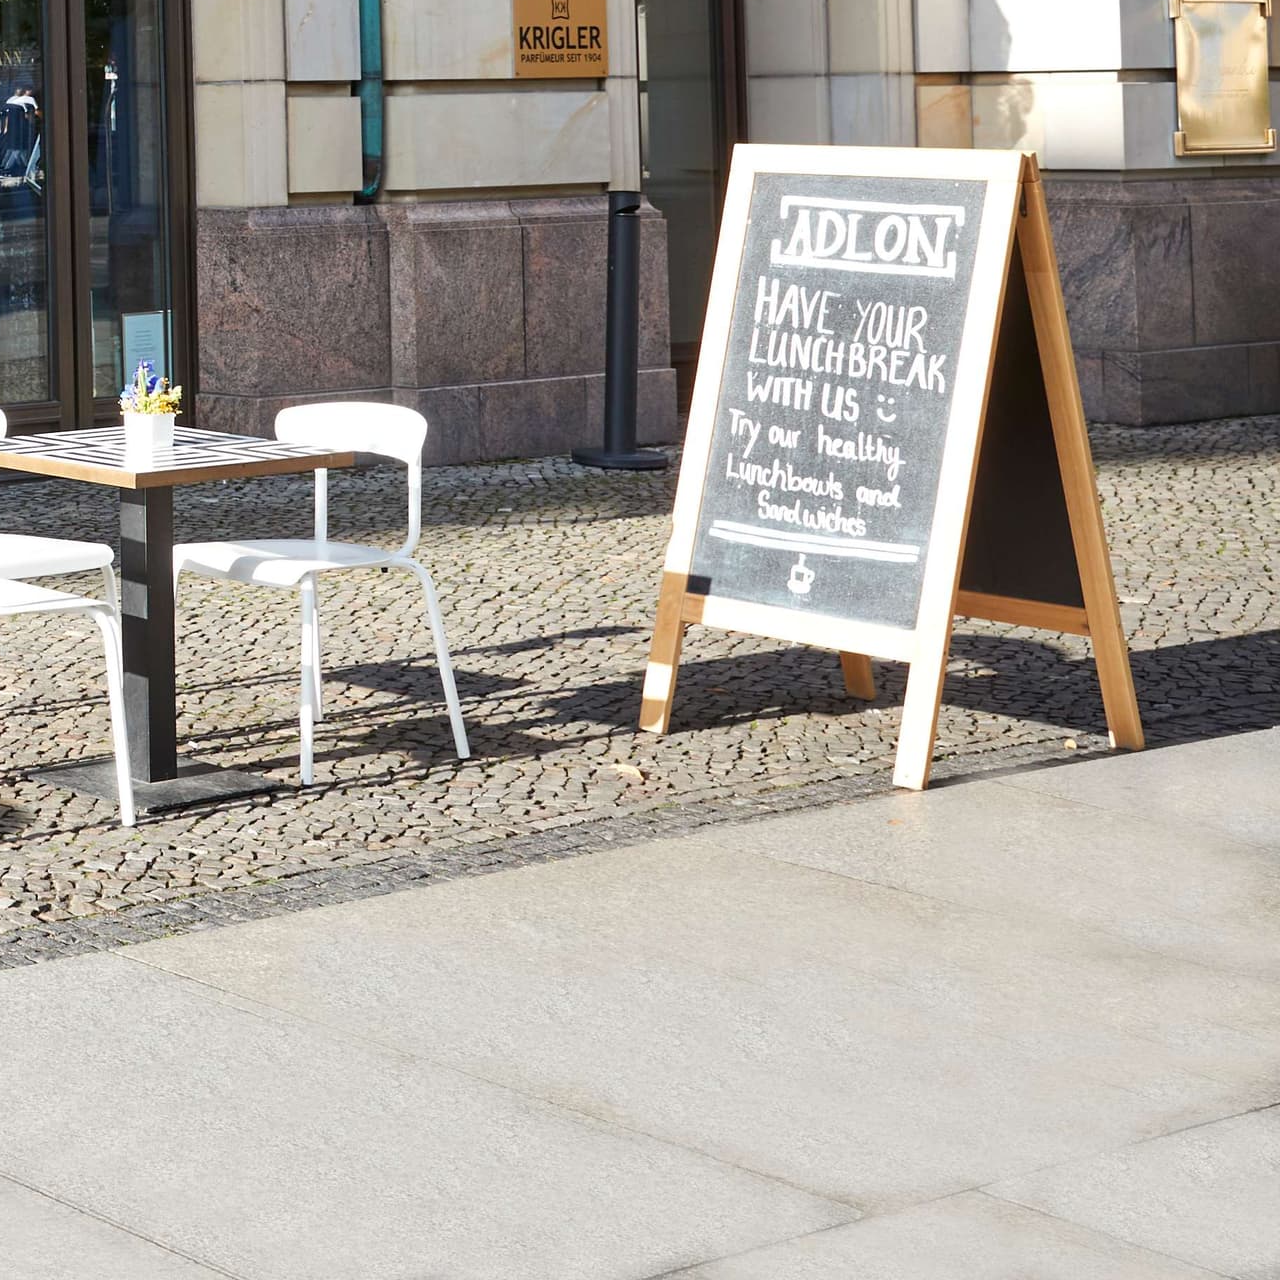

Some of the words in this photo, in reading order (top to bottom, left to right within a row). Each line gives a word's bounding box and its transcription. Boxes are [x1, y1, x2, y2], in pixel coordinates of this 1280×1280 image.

[518, 25, 602, 50] KRIGLER
[520, 51, 565, 63] PARFÜMEUR
[567, 52, 582, 63] SEIT
[584, 52, 602, 62] 1904
[783, 209, 953, 268] ADLON
[753, 275, 841, 335] HAVE
[853, 299, 928, 354] YOUR
[746, 370, 813, 411] WITH
[820, 382, 860, 422] US
[728, 407, 762, 459] Try
[768, 424, 801, 449] our
[817, 424, 906, 482] healthy
[855, 484, 902, 508] and
